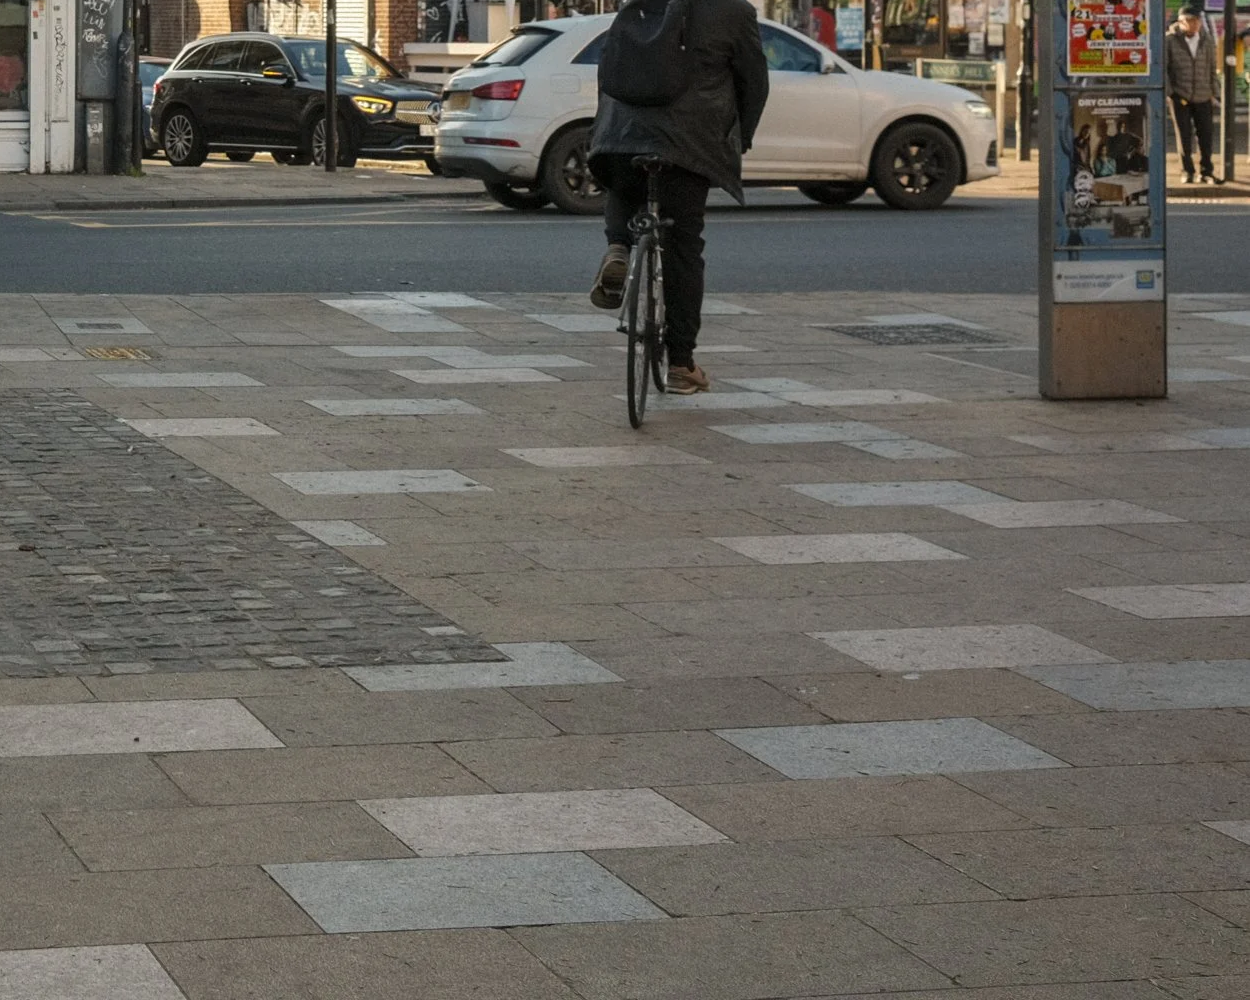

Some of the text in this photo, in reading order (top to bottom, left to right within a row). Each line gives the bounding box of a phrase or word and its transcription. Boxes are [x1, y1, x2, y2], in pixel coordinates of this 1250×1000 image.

[1075, 9, 1090, 19] 21
[1078, 97, 1142, 107] DRY CLEANING
